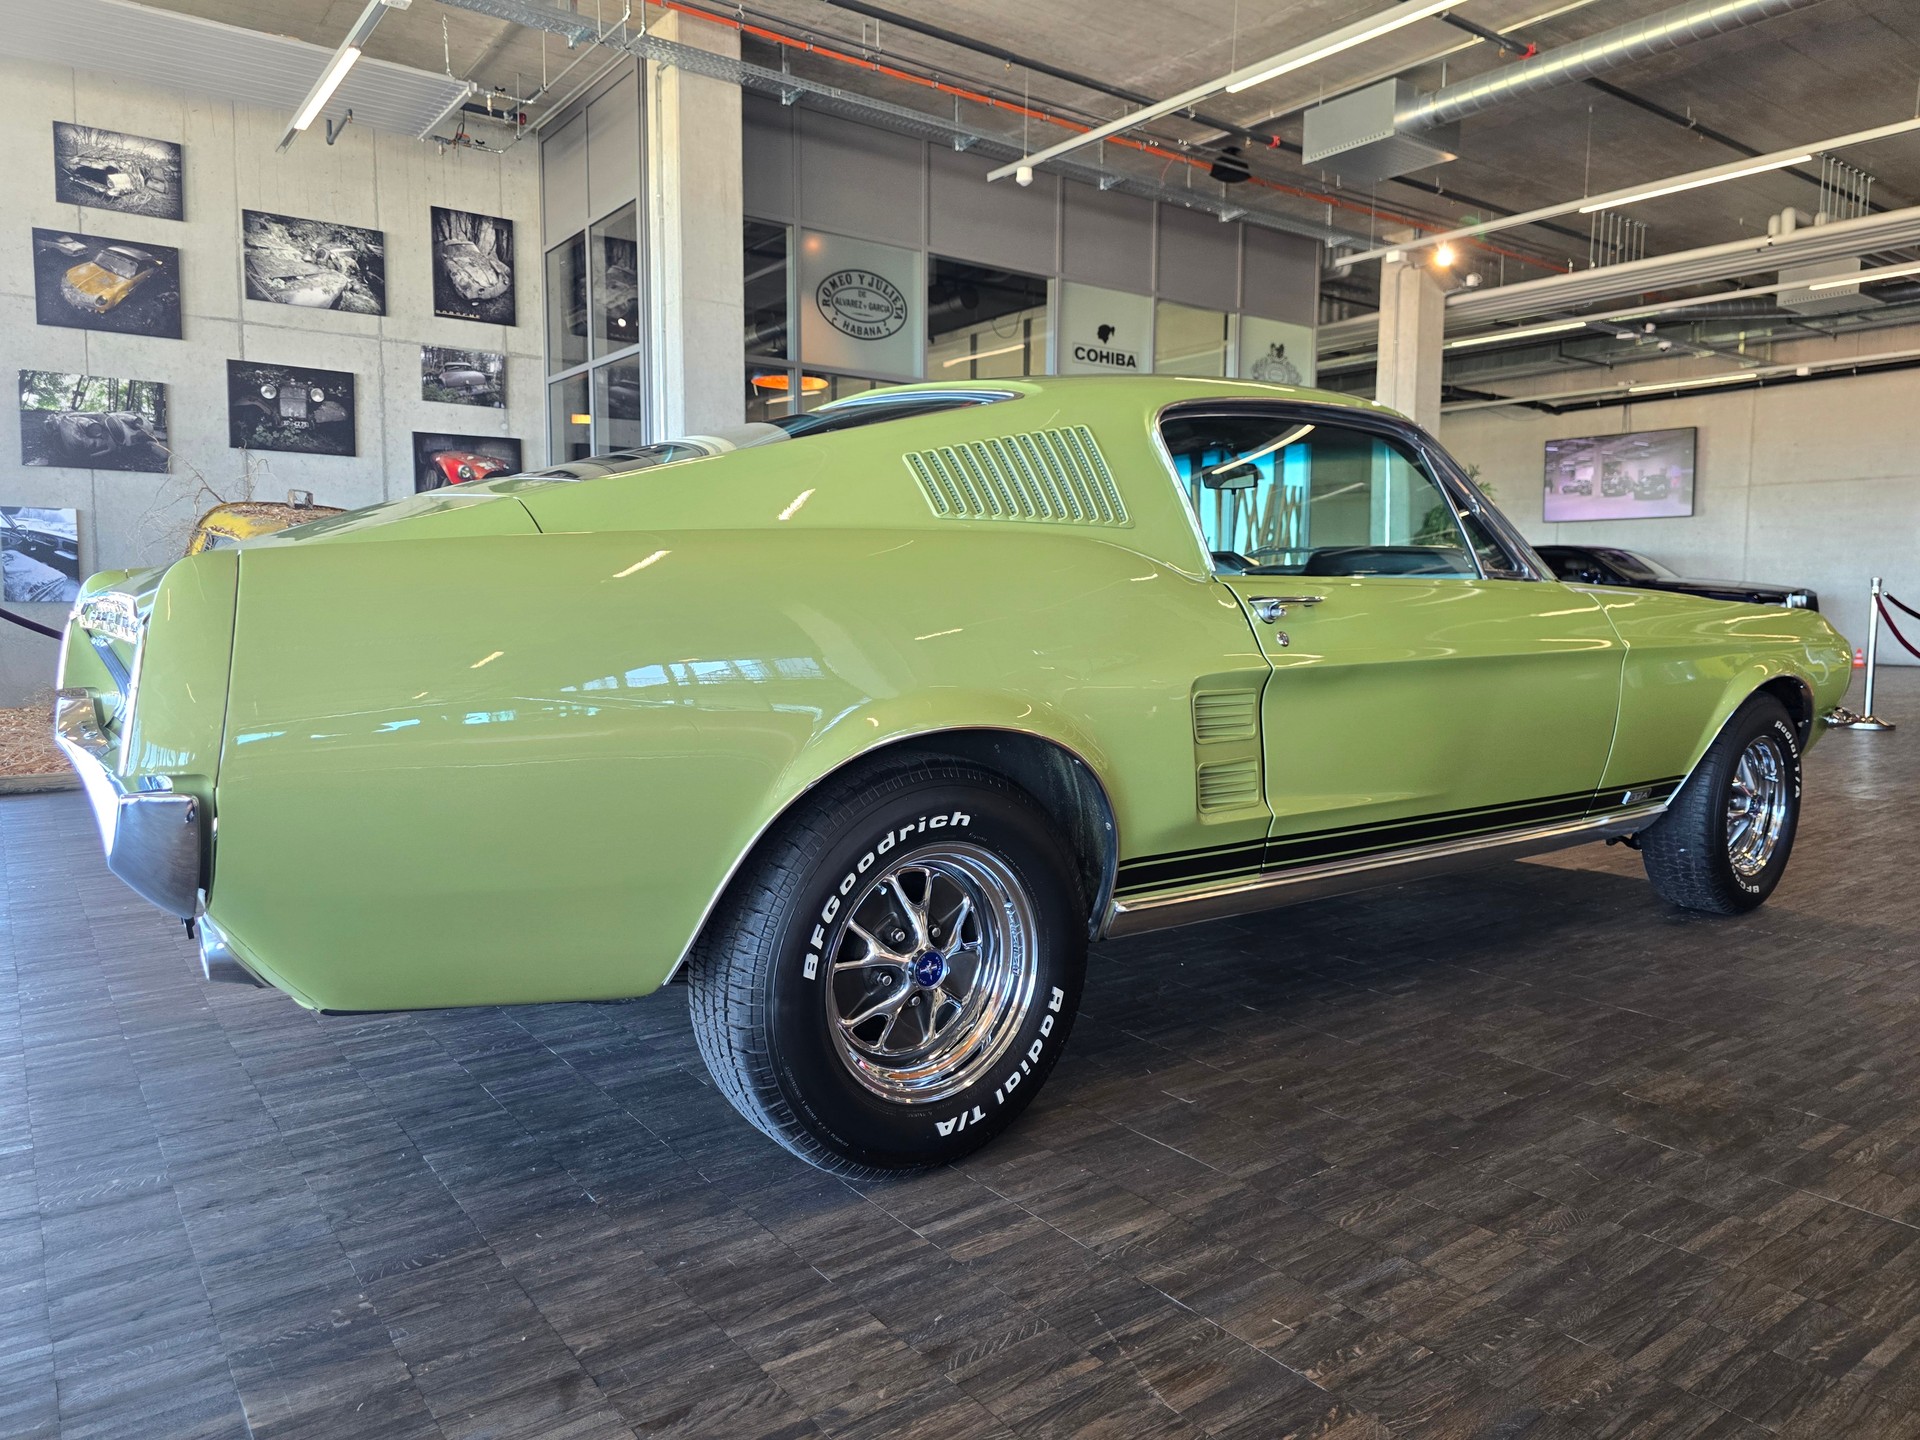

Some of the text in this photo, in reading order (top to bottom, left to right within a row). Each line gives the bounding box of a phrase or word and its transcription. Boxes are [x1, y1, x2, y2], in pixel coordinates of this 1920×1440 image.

[822, 273, 904, 320] ROMEO Y JULIETA
[834, 297, 862, 310] ALVAREZ
[842, 320, 882, 337] HABANA
[1074, 346, 1137, 369] COHIBA
[1774, 721, 1798, 759] Radial
[803, 811, 970, 980] BFGoodrich
[998, 987, 1064, 1104] Radial
[935, 1105, 986, 1136] T/A
